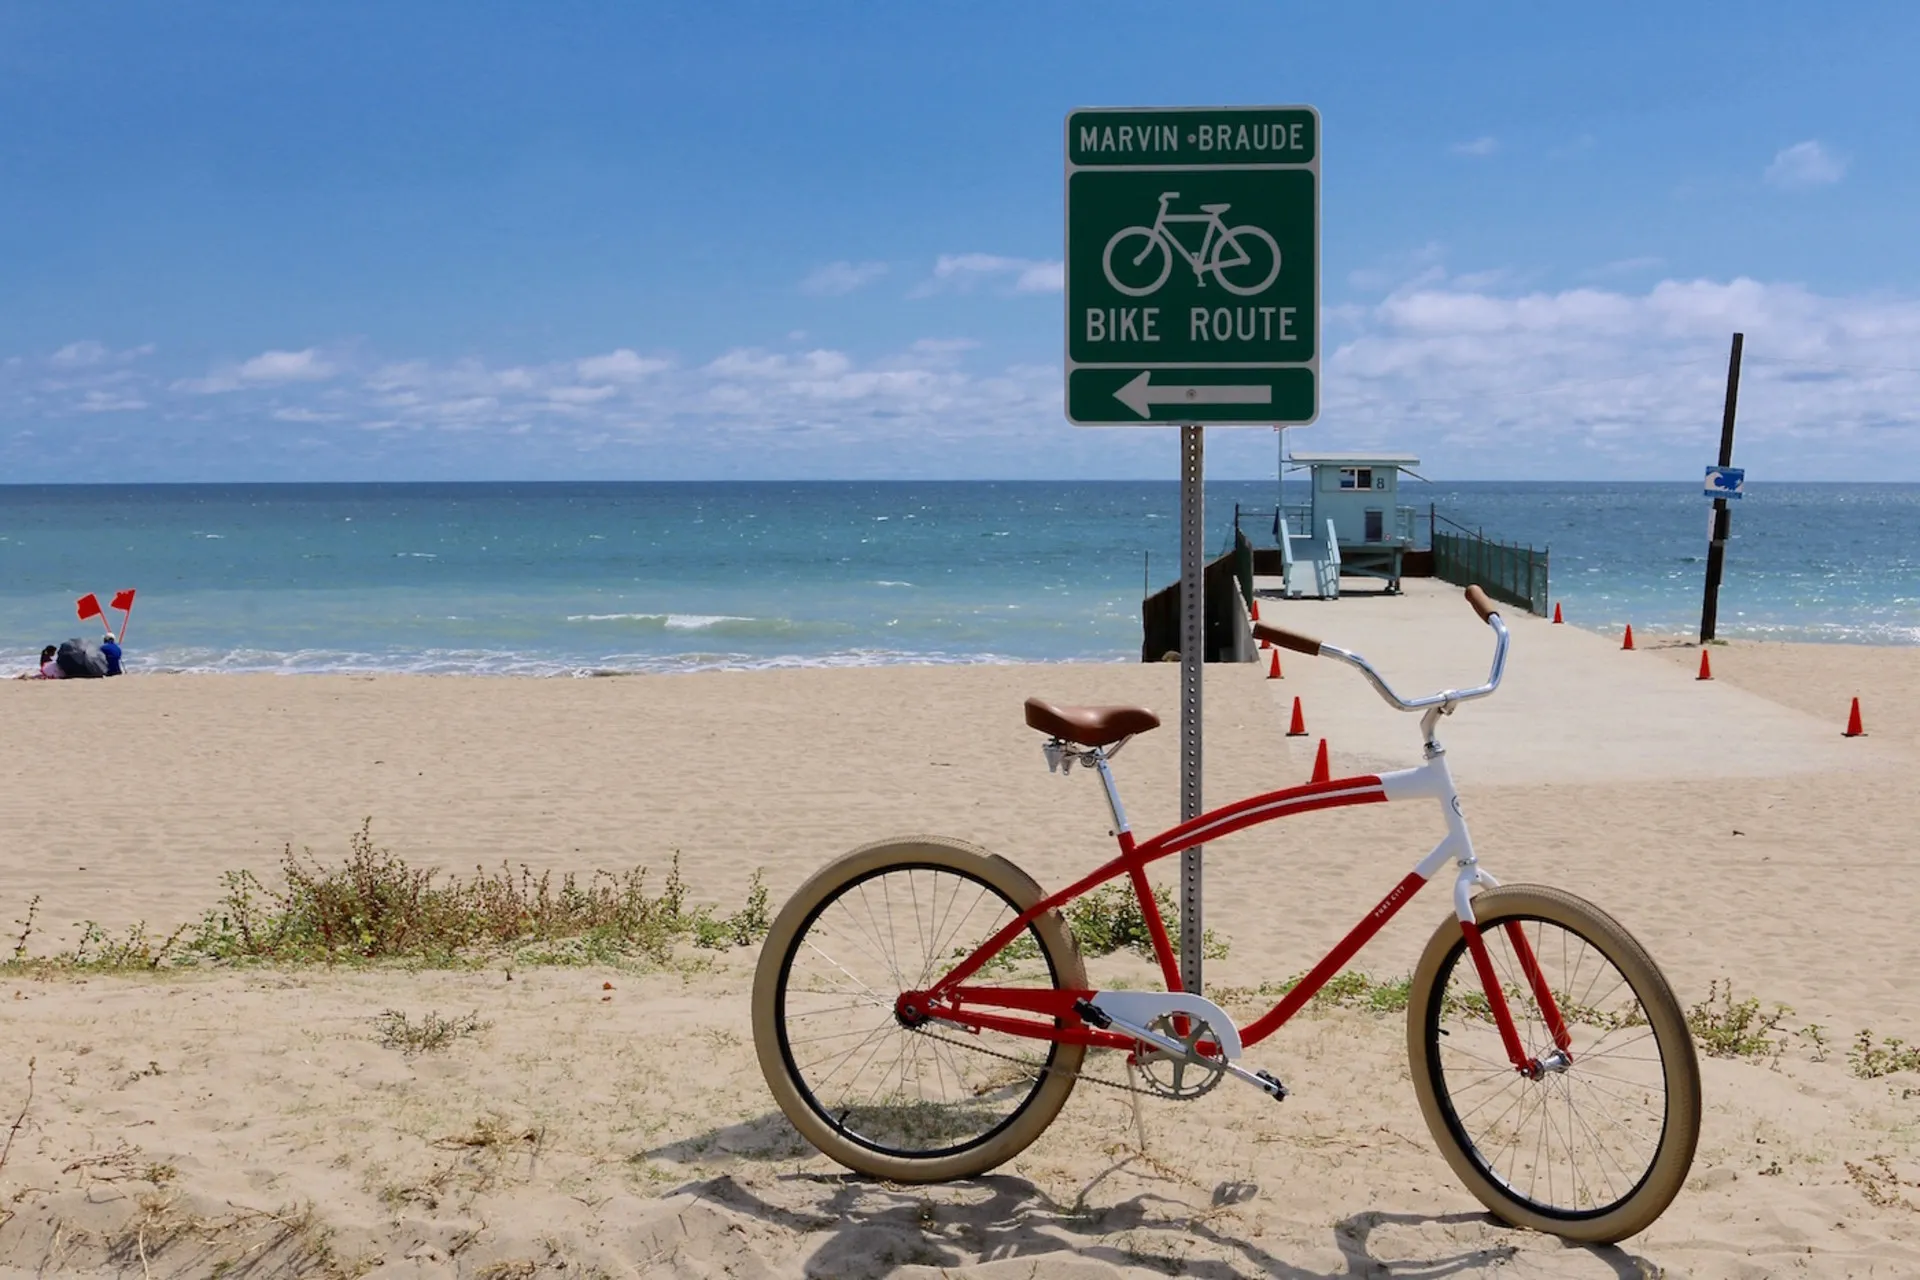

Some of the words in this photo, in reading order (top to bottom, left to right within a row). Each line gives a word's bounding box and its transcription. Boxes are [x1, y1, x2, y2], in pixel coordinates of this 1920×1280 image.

[1080, 125, 1178, 152] MARVIN
[1199, 123, 1304, 151] BRAUDE
[1086, 308, 1161, 342] BIKE
[1191, 307, 1297, 341] ROUTE
[1376, 478, 1385, 490] 8
[1390, 885, 1405, 901] CITY
